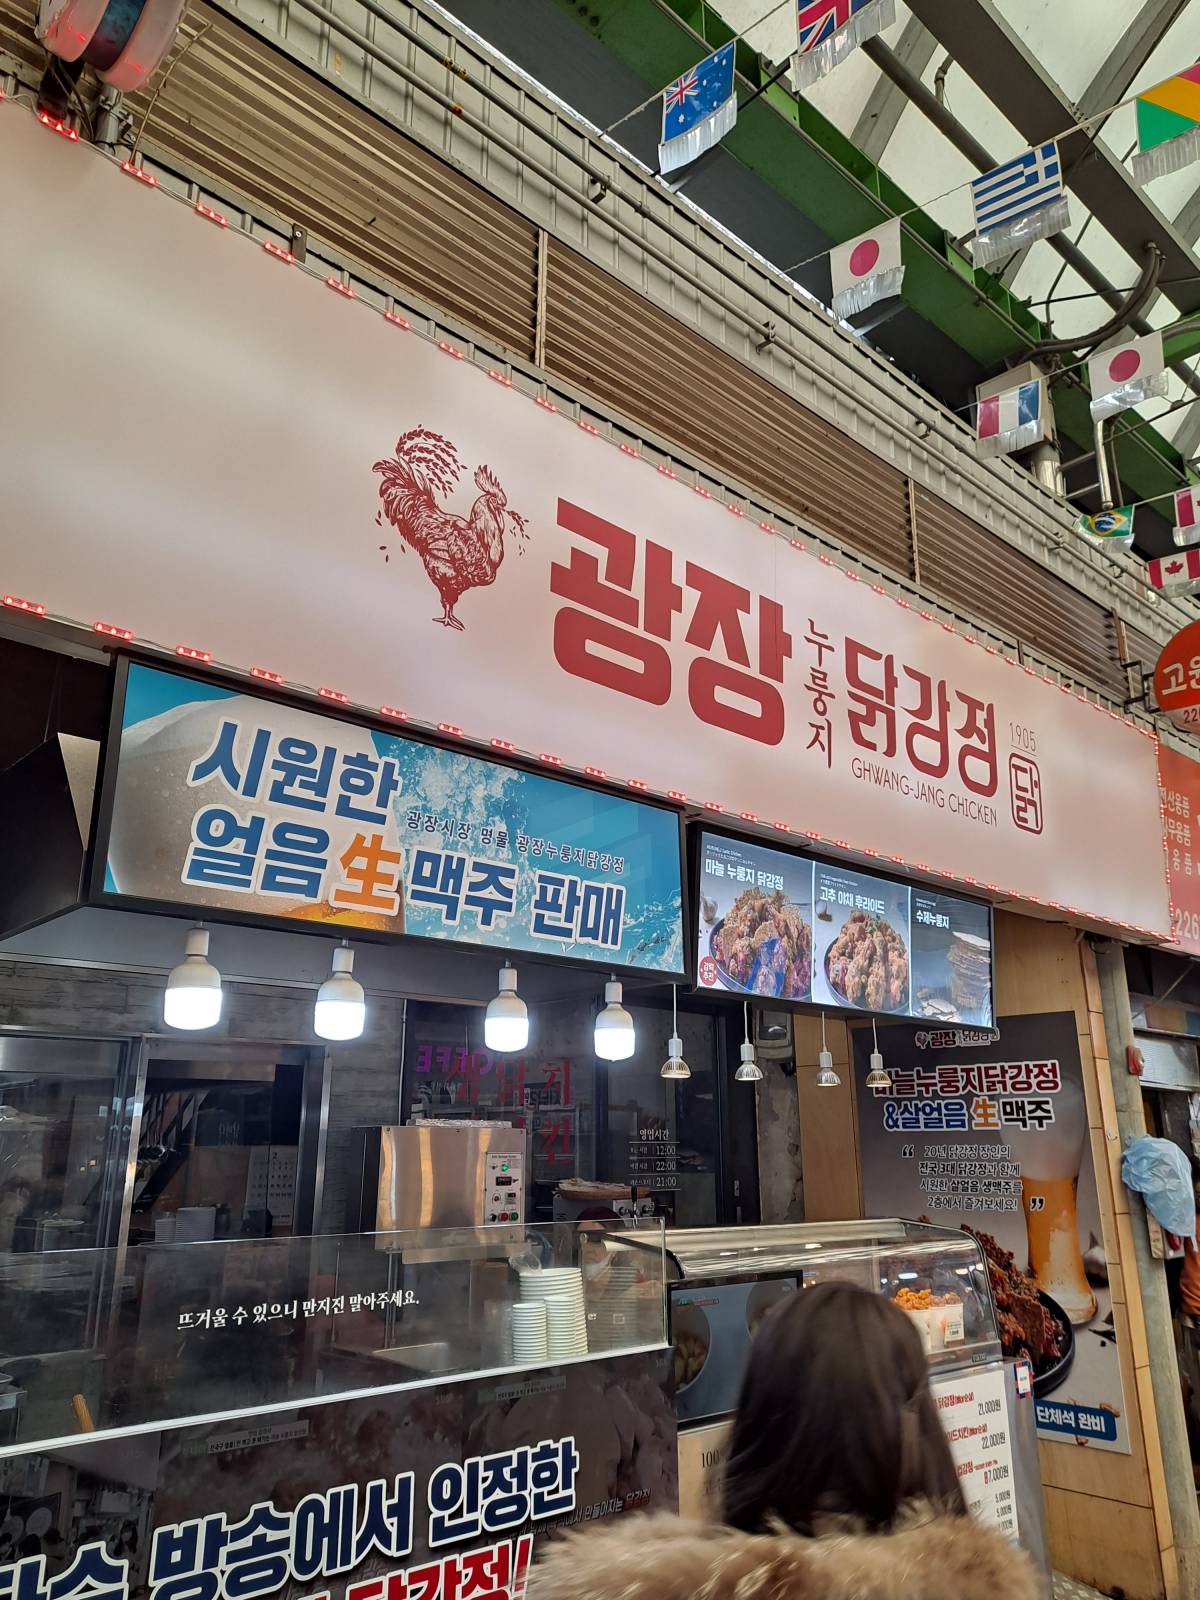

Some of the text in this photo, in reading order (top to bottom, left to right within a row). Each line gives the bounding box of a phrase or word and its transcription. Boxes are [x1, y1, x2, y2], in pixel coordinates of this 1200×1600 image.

[550, 497, 998, 798] 광장 누룽지 닭강정
[1009, 722, 1037, 752] 1905
[191, 718, 401, 823] 시원한
[851, 757, 998, 827] GHWANG-JANG CHICKEN
[406, 810, 625, 873] 광장시장 명물 광장누룽지닭강정
[184, 808, 625, 946] 얼음 生 맥주 판매
[705, 858, 784, 891] 마늘 누룽지 닭강정
[819, 886, 885, 914] 고추 야채 후라이드
[915, 909, 950, 930] 수제누룽지
[885, 1097, 1053, 1130] &살얼음 生 맥주
[639, 1128, 670, 1141] 영업시간
[656, 1145, 676, 1155] 12:00
[923, 1144, 1011, 1159] 20년 닭강정 장인의
[656, 1161, 676, 1171] 22:00
[919, 1162, 1020, 1177] 전국 3대 닭강정과 함께
[656, 1177, 677, 1187] 21:00
[920, 1179, 1023, 1195] 시원한 살얼음 생맥주를
[927, 1196, 1017, 1211] 2층에서 즐겨보세요!
[177, 1289, 420, 1330] 뜨거울 수 있으니 만지진 말아주세요.
[1036, 1406, 1106, 1432] 단체석 완비
[150, 1472, 414, 1600] 방송에서
[429, 1437, 579, 1547] 인정한
